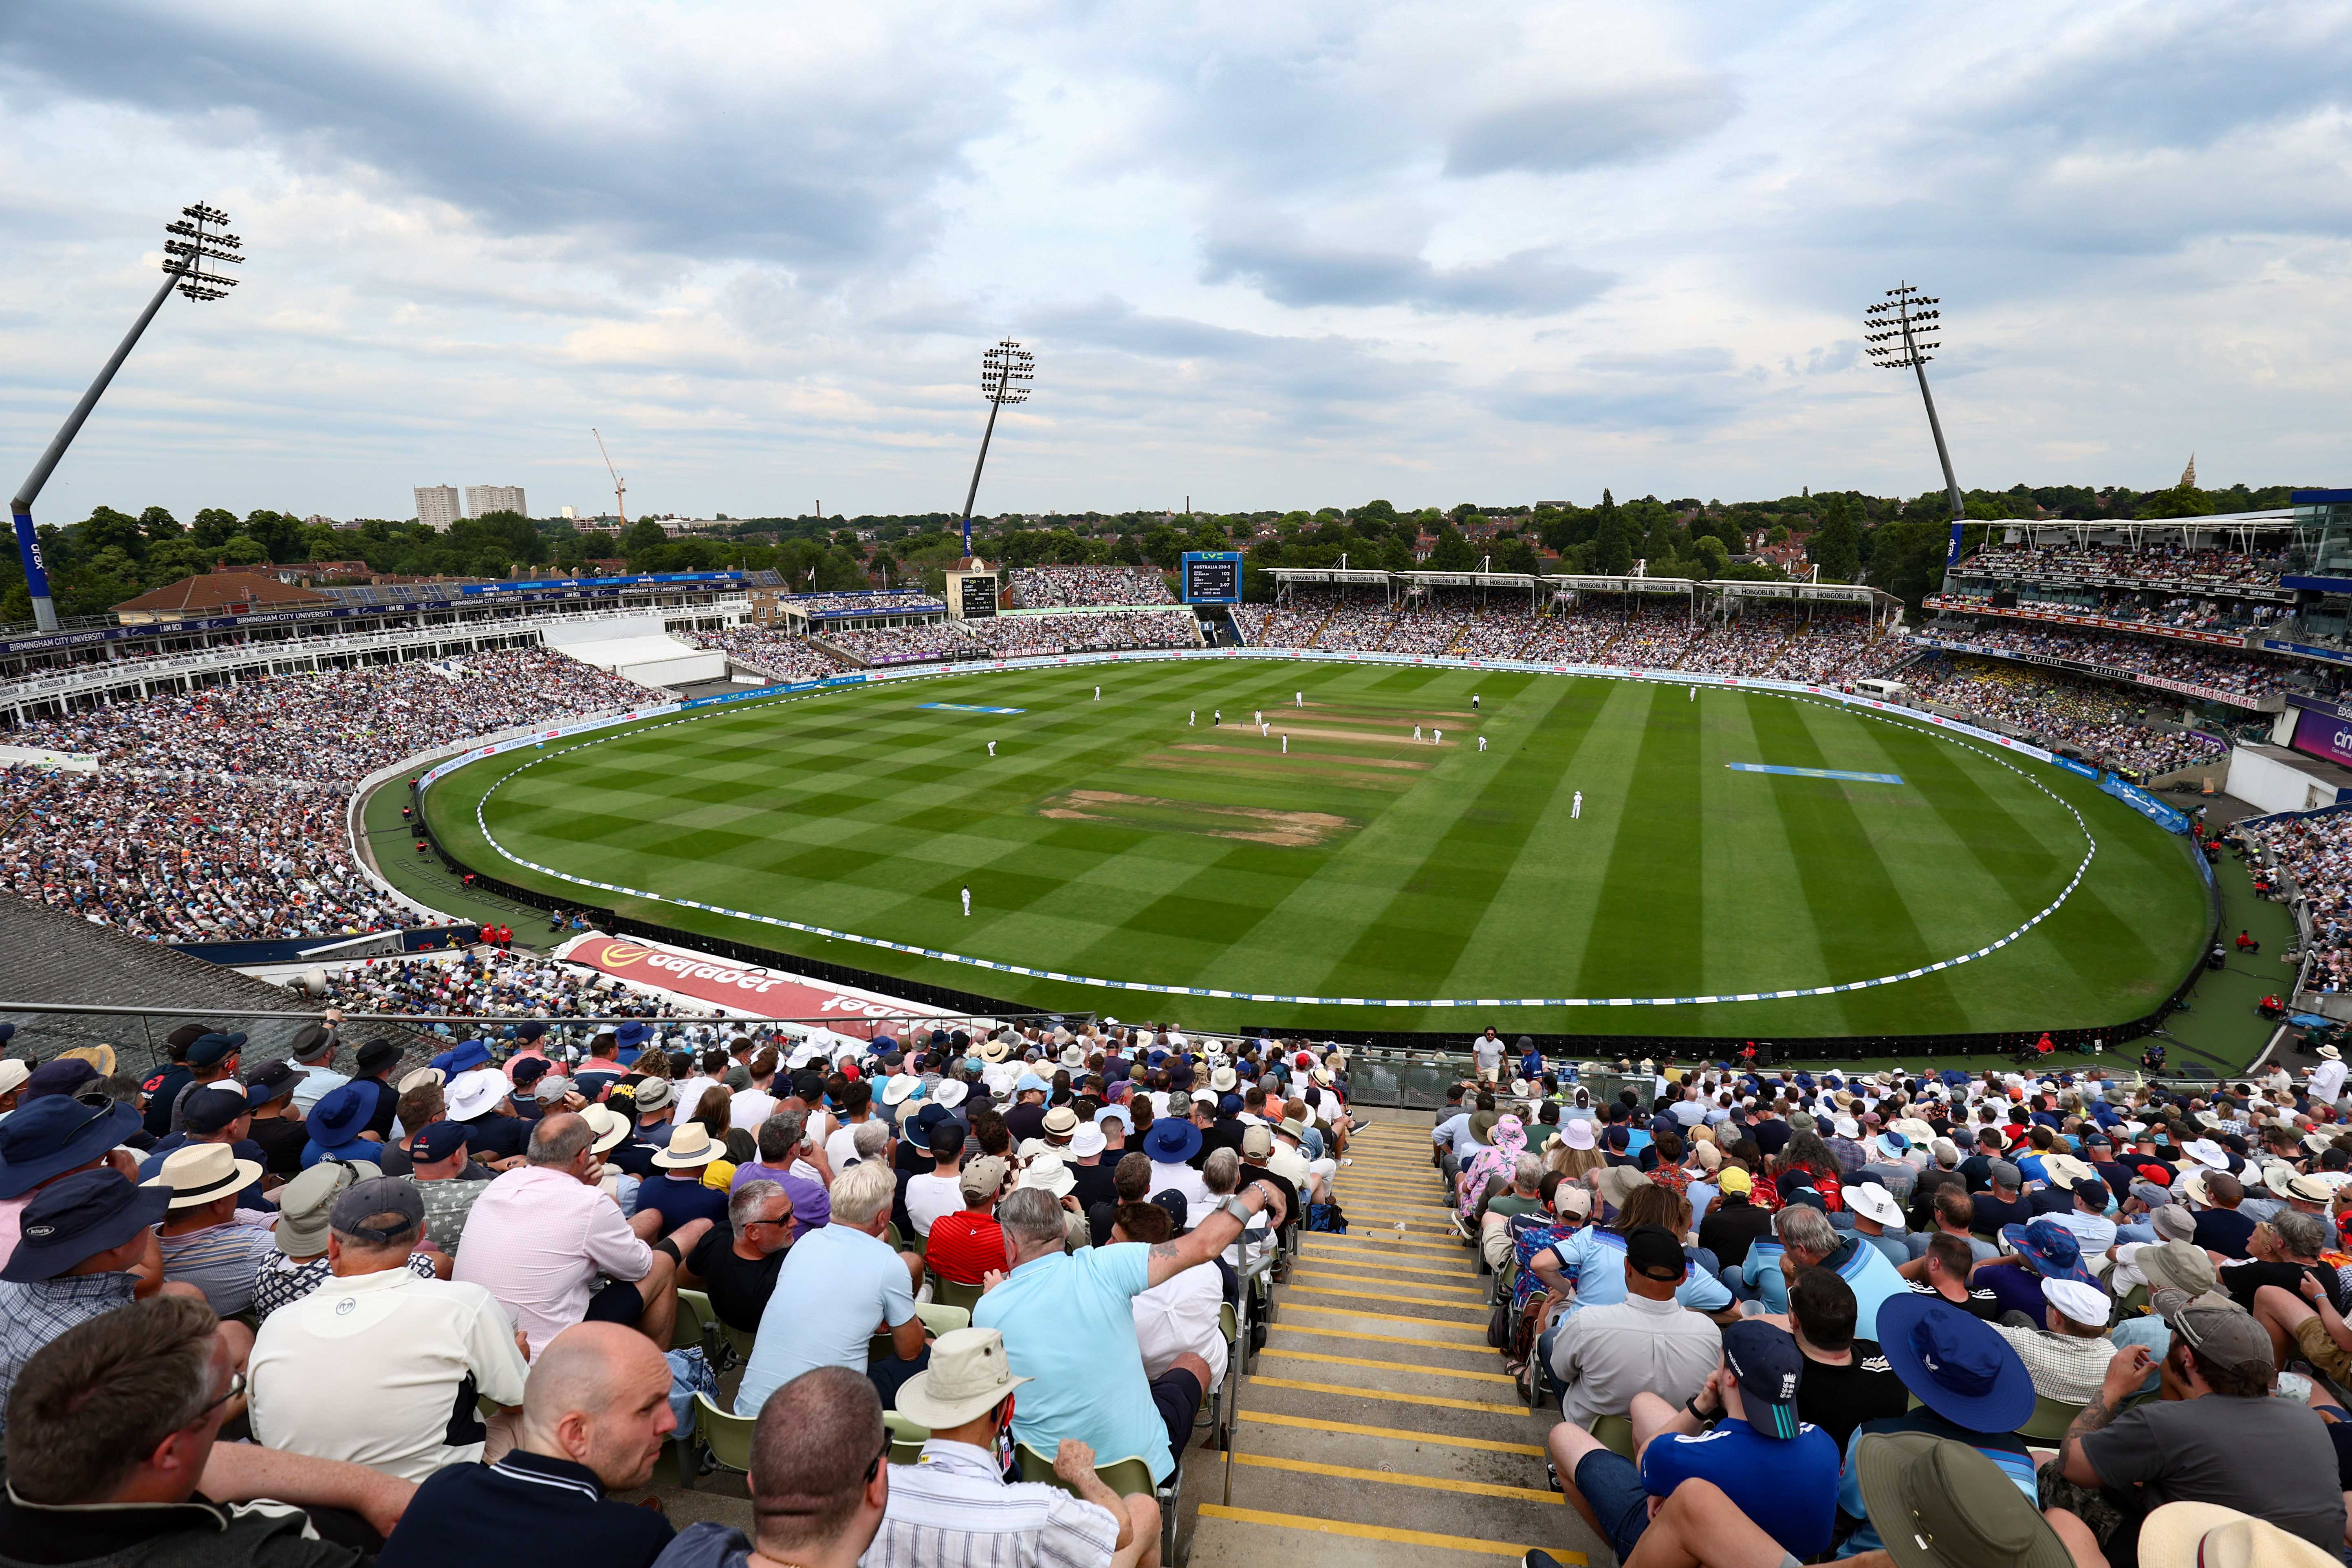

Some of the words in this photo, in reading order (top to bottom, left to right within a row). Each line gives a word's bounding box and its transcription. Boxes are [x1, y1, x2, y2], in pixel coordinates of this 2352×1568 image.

[1947, 539, 1956, 557] drax
[31, 544, 44, 569] drax
[1644, 584, 1676, 592] HOBGOBLIN
[451, 598, 483, 607] BIRMINGHAM
[496, 595, 523, 603] UNIVERSITY
[1817, 591, 1853, 601] HOBGOBLIN
[237, 614, 277, 625] BIRMINGHAM
[295, 610, 333, 619] UNIVERSITY
[172, 623, 182, 631] BCU
[9, 638, 53, 652] BIRMINGHAM
[55, 636, 68, 645] CITY
[70, 632, 105, 644] UNIVERSITY
[348, 636, 373, 645] HOBGOBLIN
[257, 645, 284, 655] HOBGOBLIN
[1966, 645, 1983, 653] RADOX
[1993, 649, 2009, 657] RADOX
[214, 651, 241, 661] HOBGOBLIN
[2034, 656, 2062, 665] CASTORE
[169, 657, 197, 668] HOBGOBLIN
[123, 664, 149, 674] HOBGOBLIN
[2100, 667, 2129, 678] CASTORE
[83, 670, 108, 682] HOBGOBLIN
[37, 678, 66, 689] HOBGOBLIN
[1901, 708, 1923, 718] HIGHLIGHTS
[562, 724, 590, 734] DOWNLOAD
[1945, 720, 1968, 731] DOWNLOAD
[512, 736, 536, 747] STREAMING
[2025, 745, 2048, 759] STREAMING
[436, 762, 456, 774] DOWNLOAD
[647, 954, 783, 993] dafabet
[1728, 1348, 1743, 1377] waitrose
